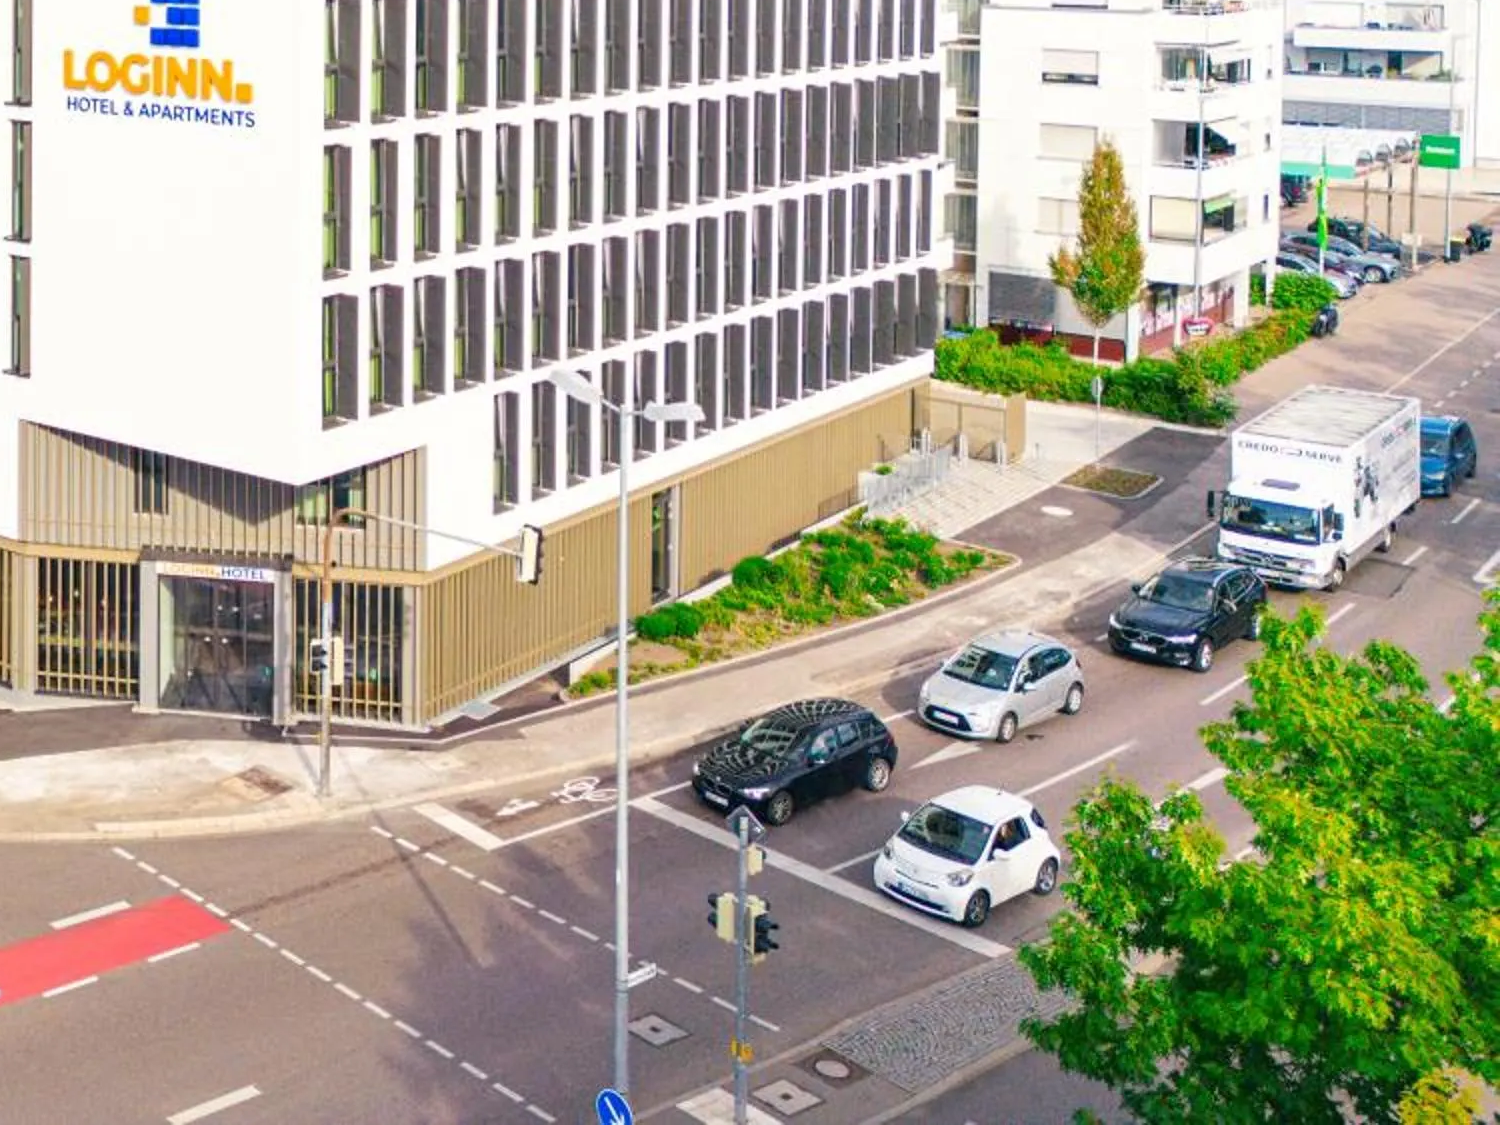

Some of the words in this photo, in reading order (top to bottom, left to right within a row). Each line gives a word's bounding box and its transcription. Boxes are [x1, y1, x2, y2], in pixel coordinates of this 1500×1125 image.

[67, 96, 118, 116] HOTEL
[123, 100, 134, 117] &
[138, 103, 256, 128] APARTMENTS
[221, 566, 264, 580] HOTEL
